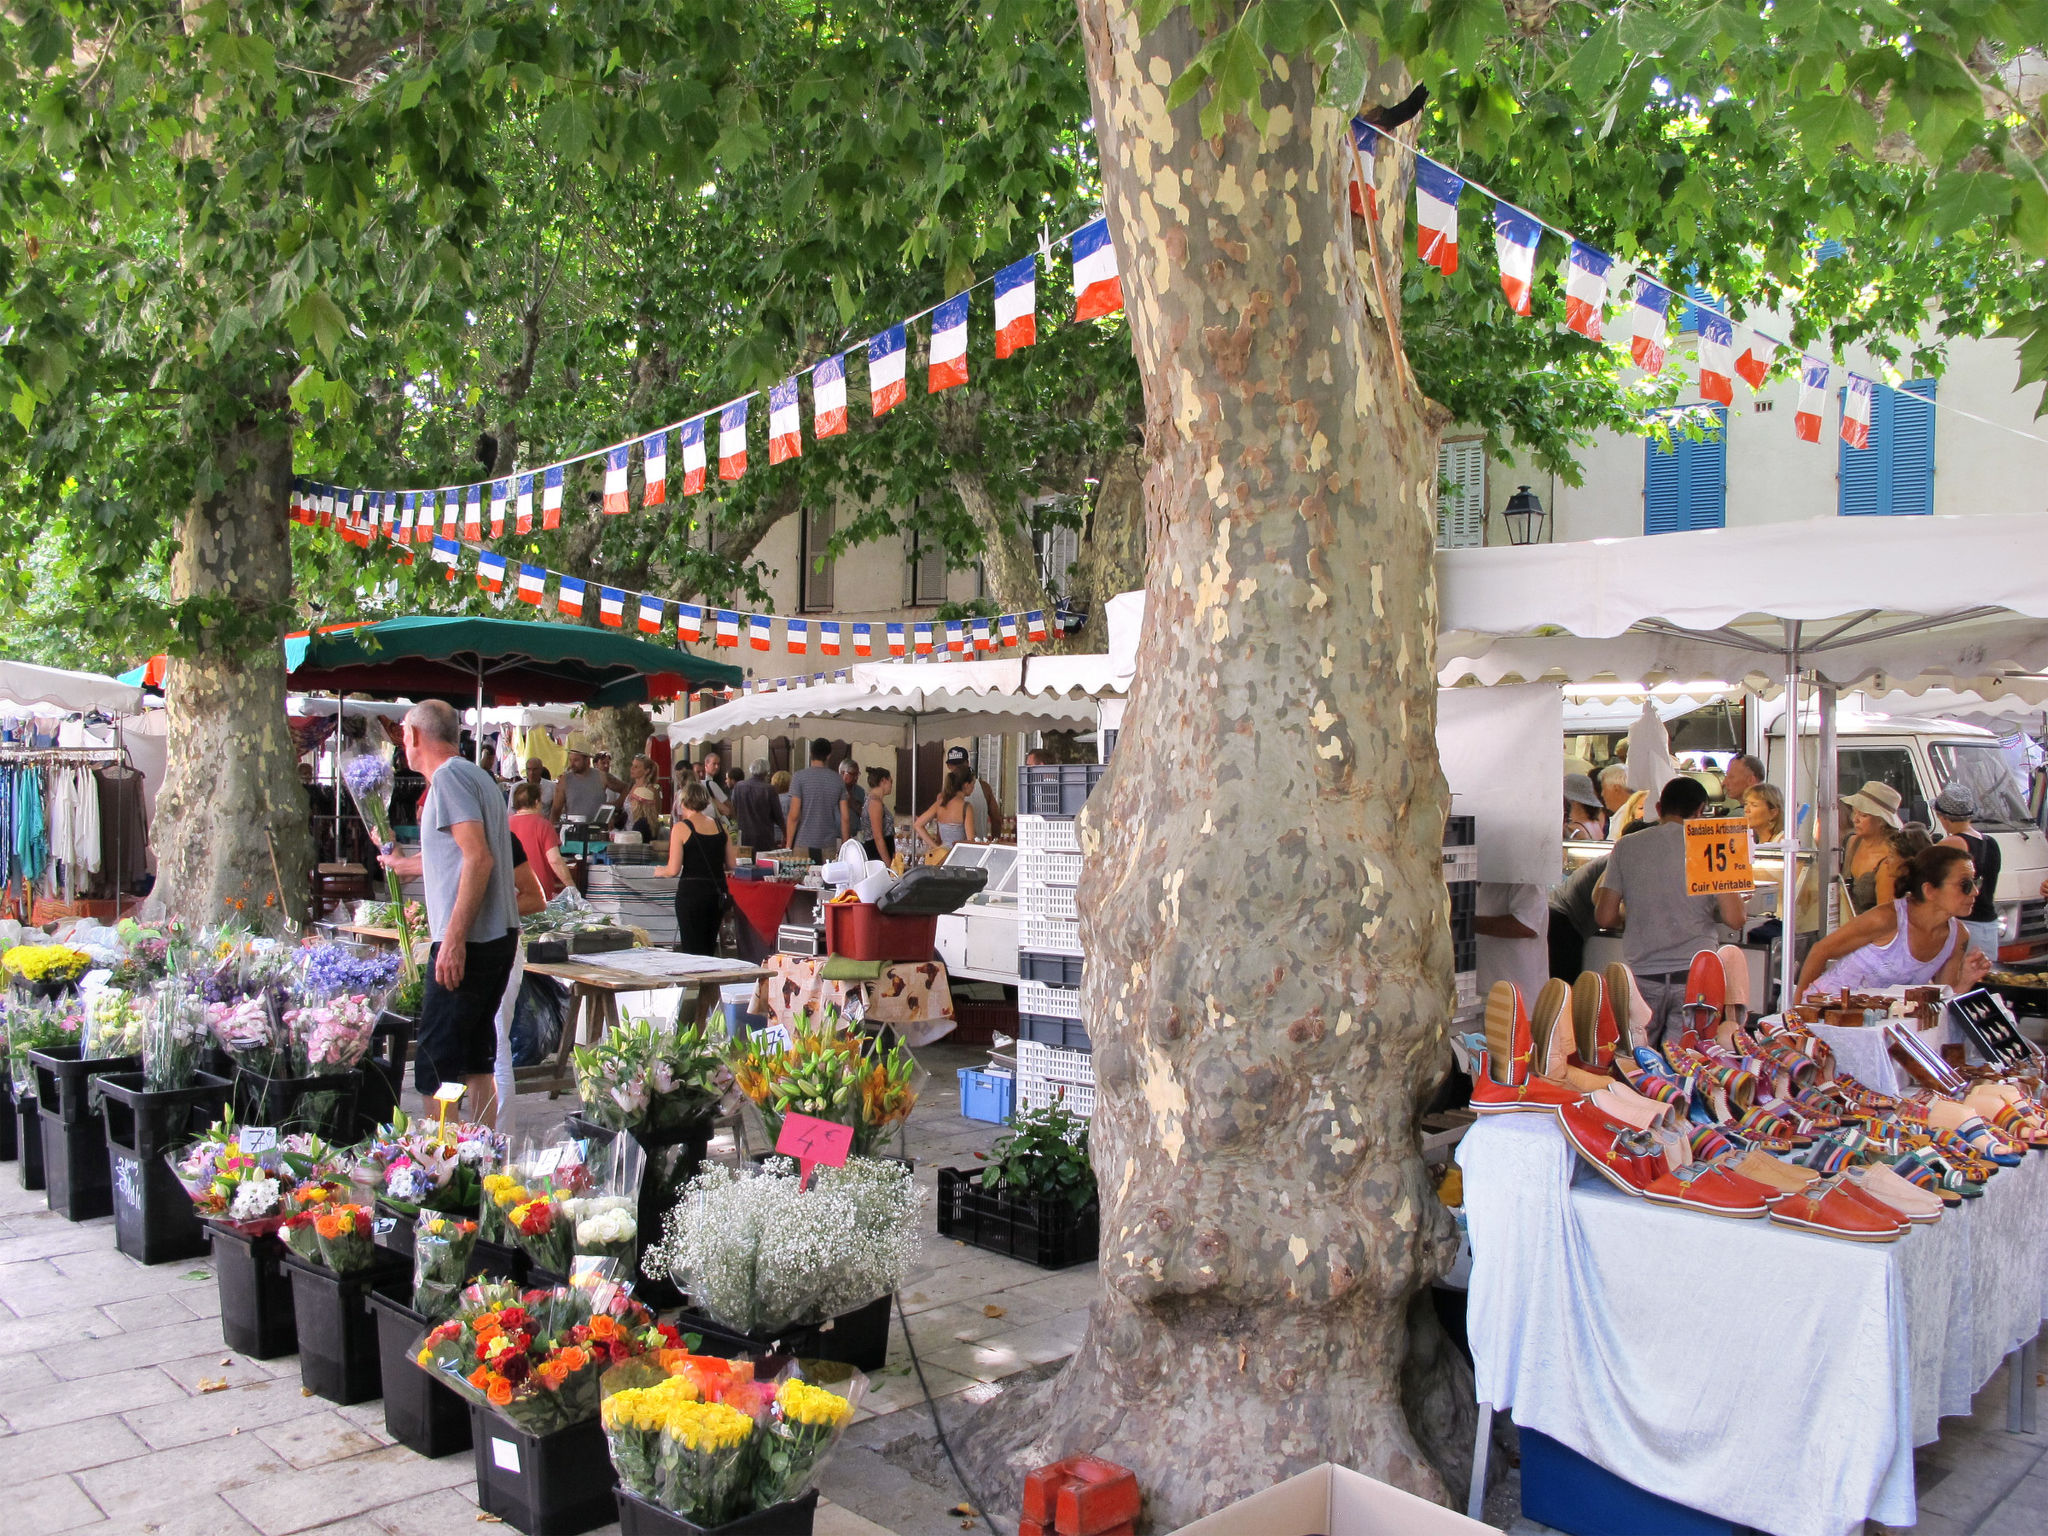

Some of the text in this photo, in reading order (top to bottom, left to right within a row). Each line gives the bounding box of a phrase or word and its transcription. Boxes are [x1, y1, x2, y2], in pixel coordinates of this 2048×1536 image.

[1687, 822, 1748, 836] Sandales Artisanales
[1691, 879, 1752, 892] Cuir Véritable
